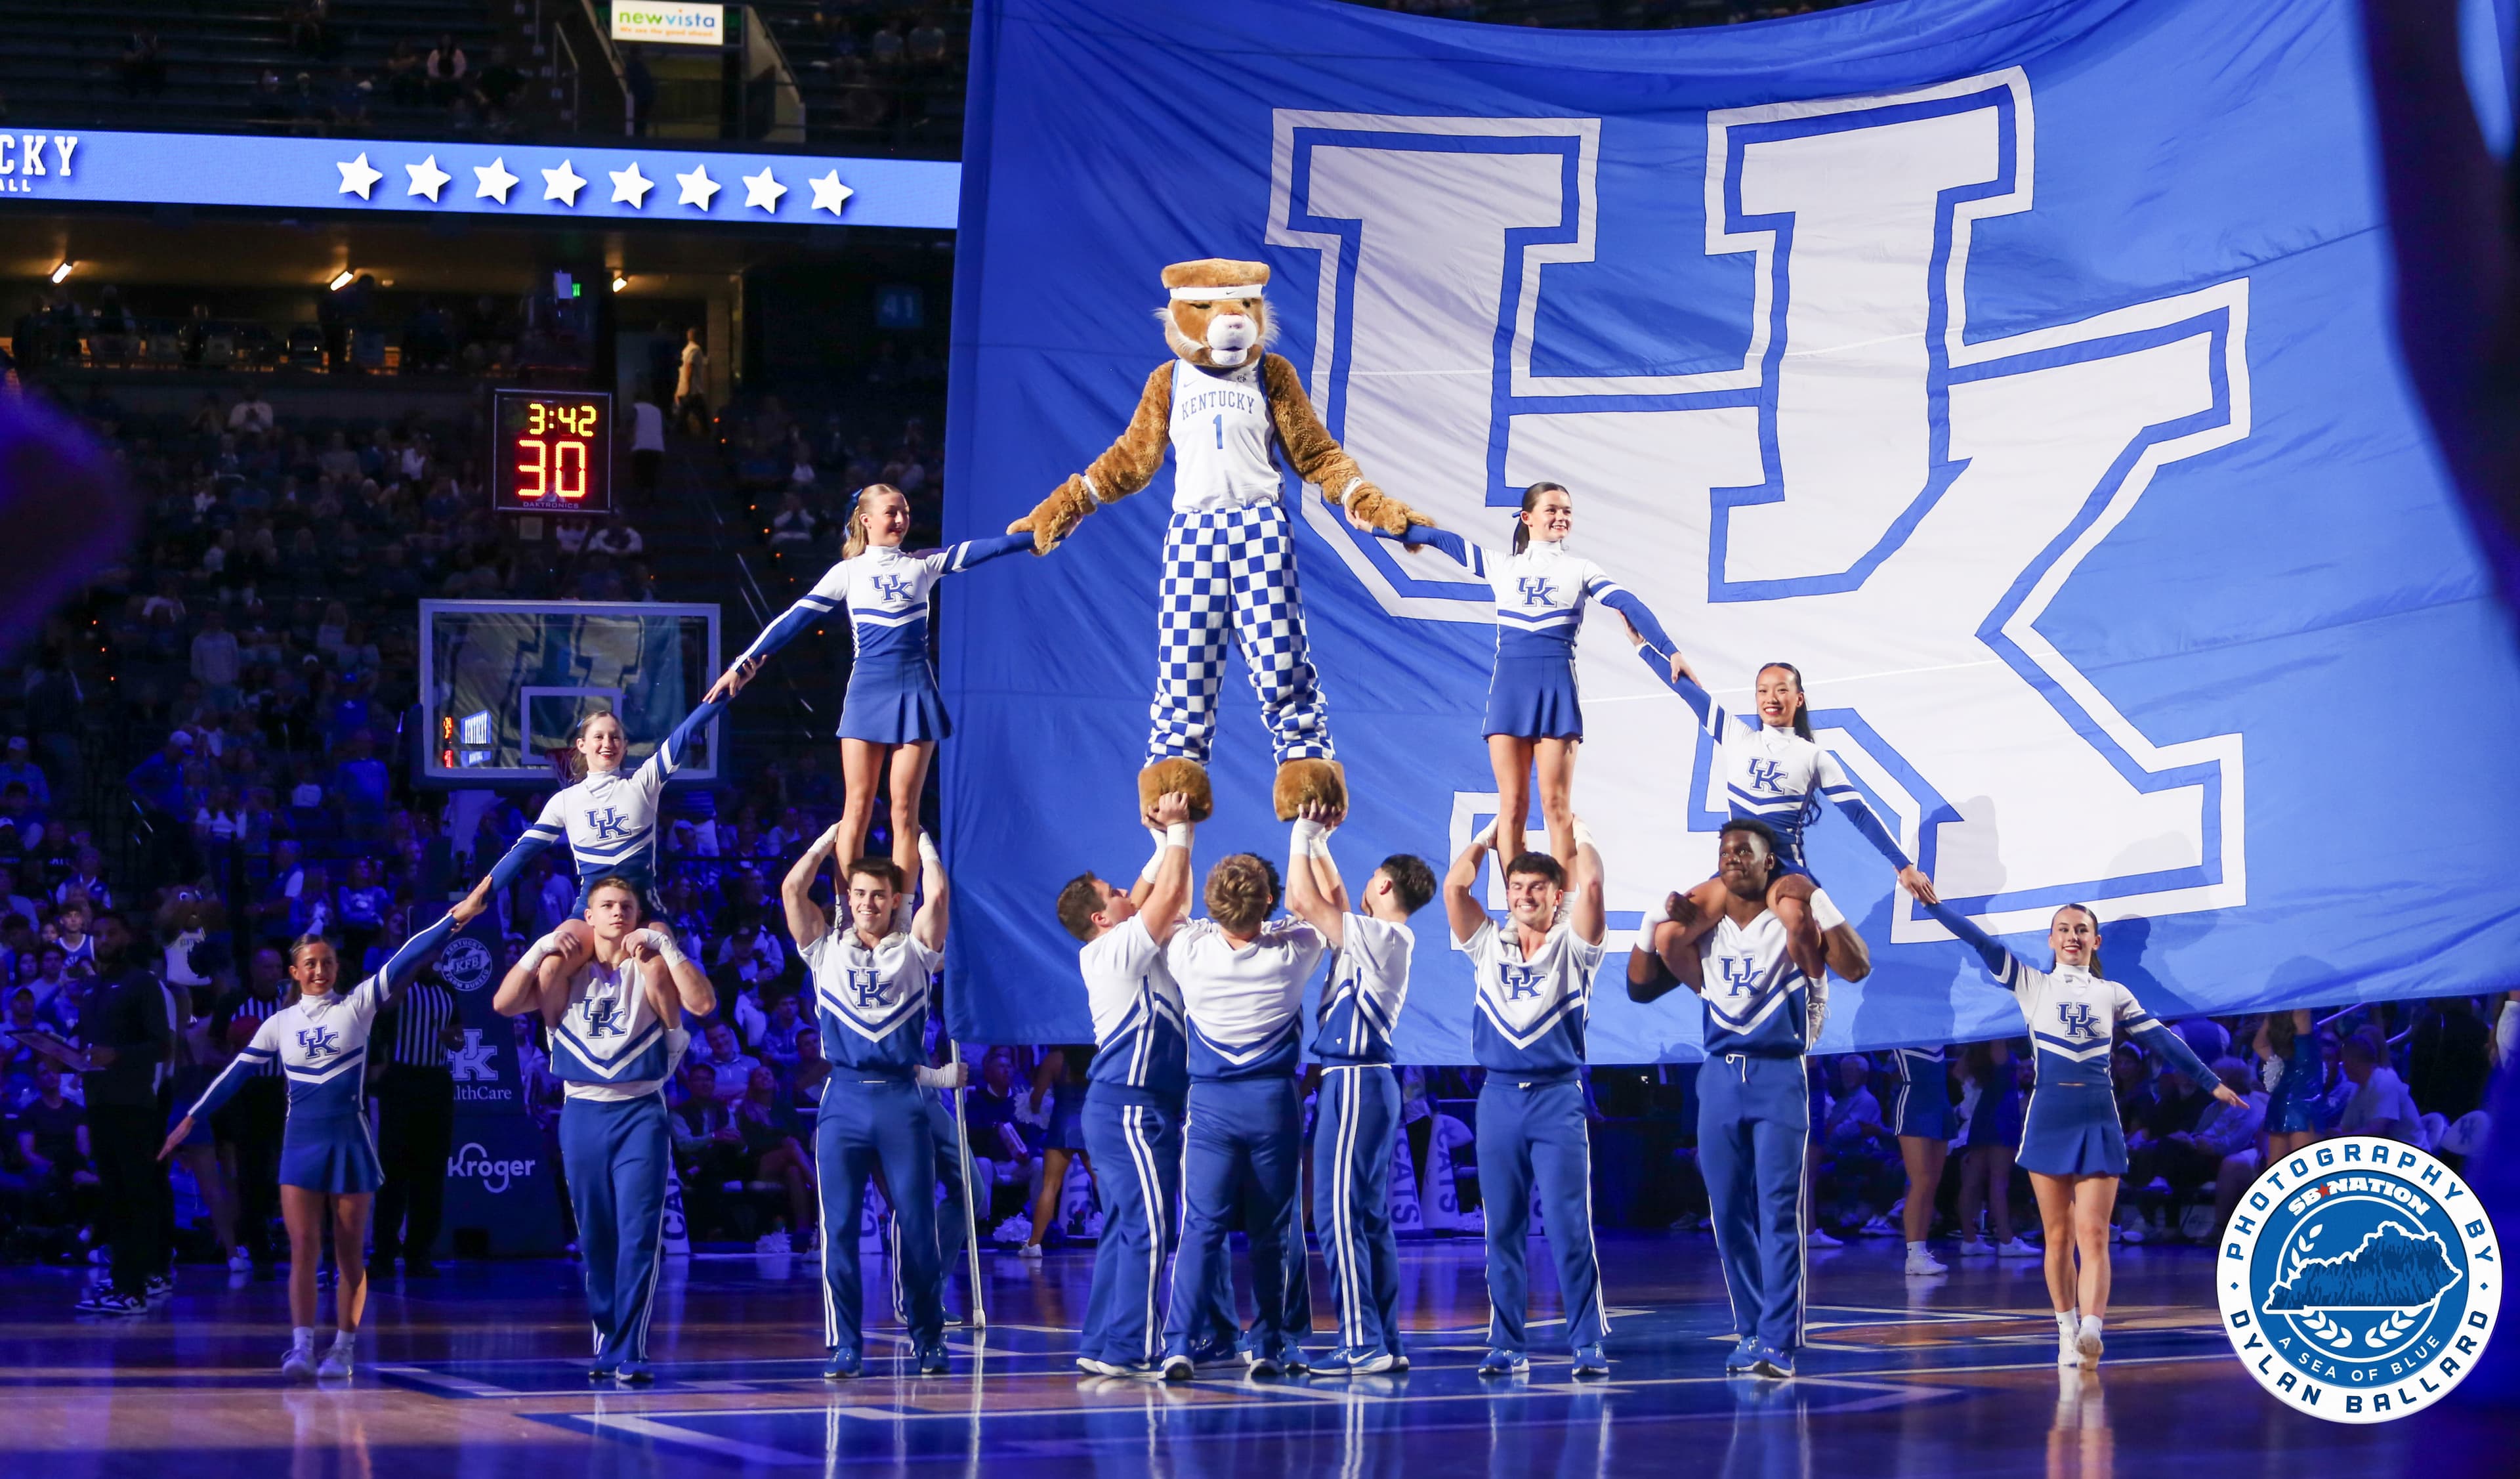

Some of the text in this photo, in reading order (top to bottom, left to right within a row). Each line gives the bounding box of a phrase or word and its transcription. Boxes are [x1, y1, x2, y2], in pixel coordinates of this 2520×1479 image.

[620, 9, 715, 28] new vista
[0, 135, 78, 177] CKY
[530, 404, 596, 437] 3:42
[1182, 391, 1254, 420] KENTUCKY
[1213, 414, 1223, 449] 1
[518, 440, 585, 497] 30
[869, 572, 914, 603] UK
[1516, 576, 1559, 608] UK
[1746, 756, 1788, 795] UK
[584, 805, 631, 841] UK
[446, 939, 482, 956] KENTUCKY
[455, 956, 480, 972] KFB
[445, 970, 490, 989] FARM BUREAU
[845, 966, 893, 1008] UK
[1497, 960, 1547, 1002] UK
[1718, 954, 1766, 998] UK
[583, 997, 628, 1039] UK
[2056, 1002, 2101, 1039] UK
[296, 1024, 341, 1060] UK
[453, 1085, 512, 1100] lthCare
[448, 1143, 536, 1193] Kroger
[1391, 1138, 1419, 1224] CATS
[1437, 1127, 1456, 1212] CATS
